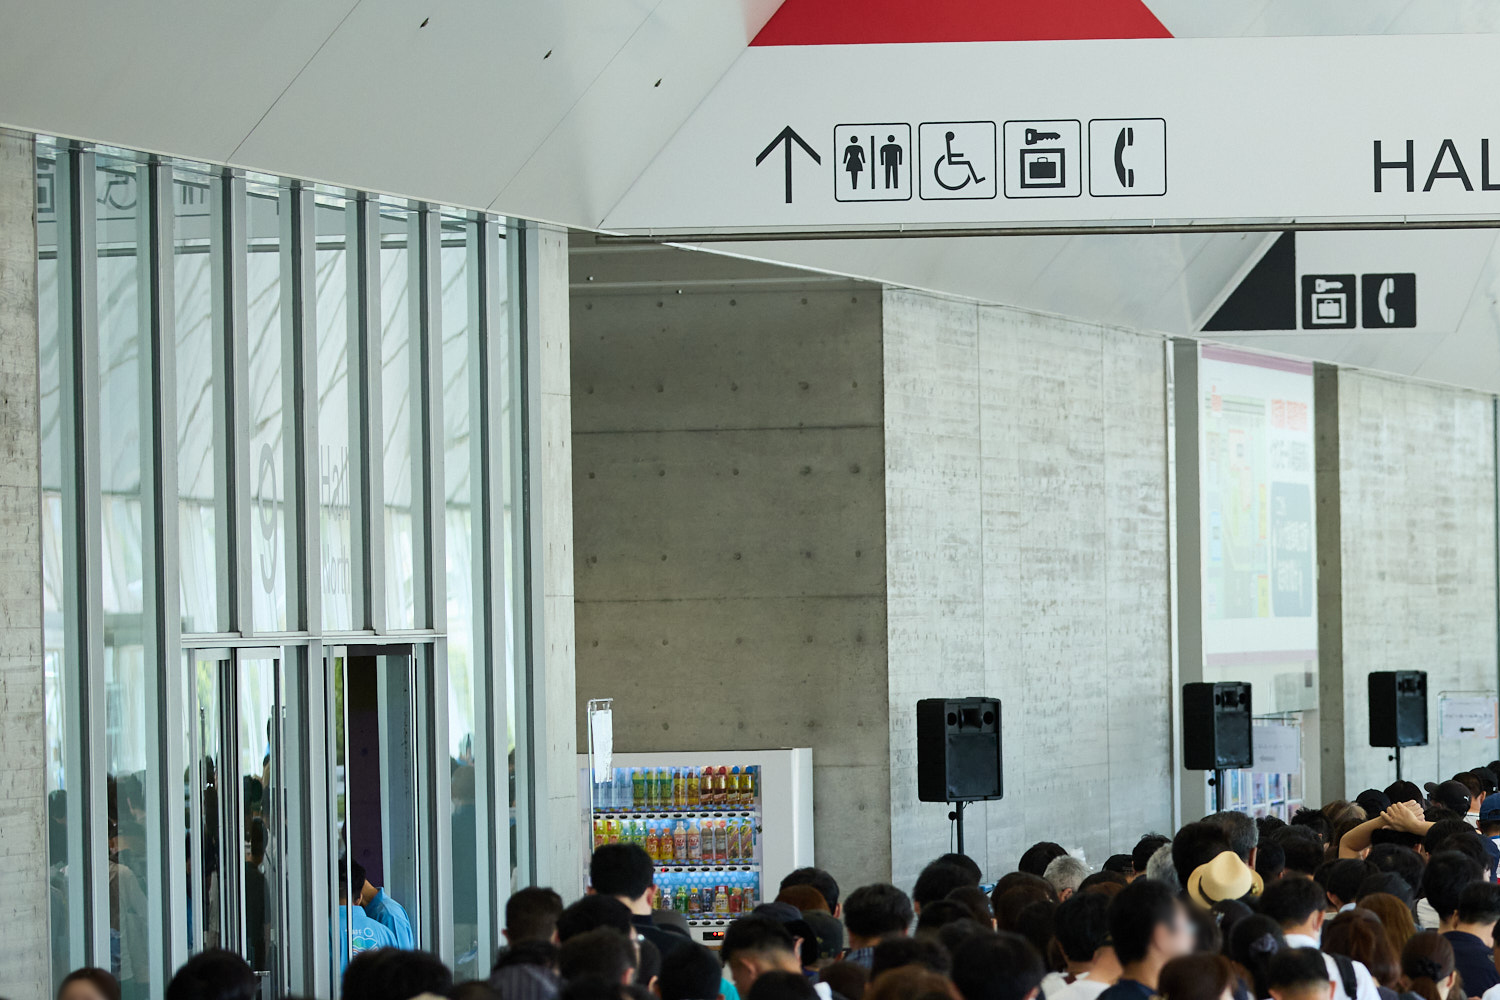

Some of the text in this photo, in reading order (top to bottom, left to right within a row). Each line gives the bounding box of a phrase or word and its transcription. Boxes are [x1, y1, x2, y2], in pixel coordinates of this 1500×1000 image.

[258, 442, 278, 594] 9
[320, 444, 349, 521] Hall
[322, 543, 350, 594] North
